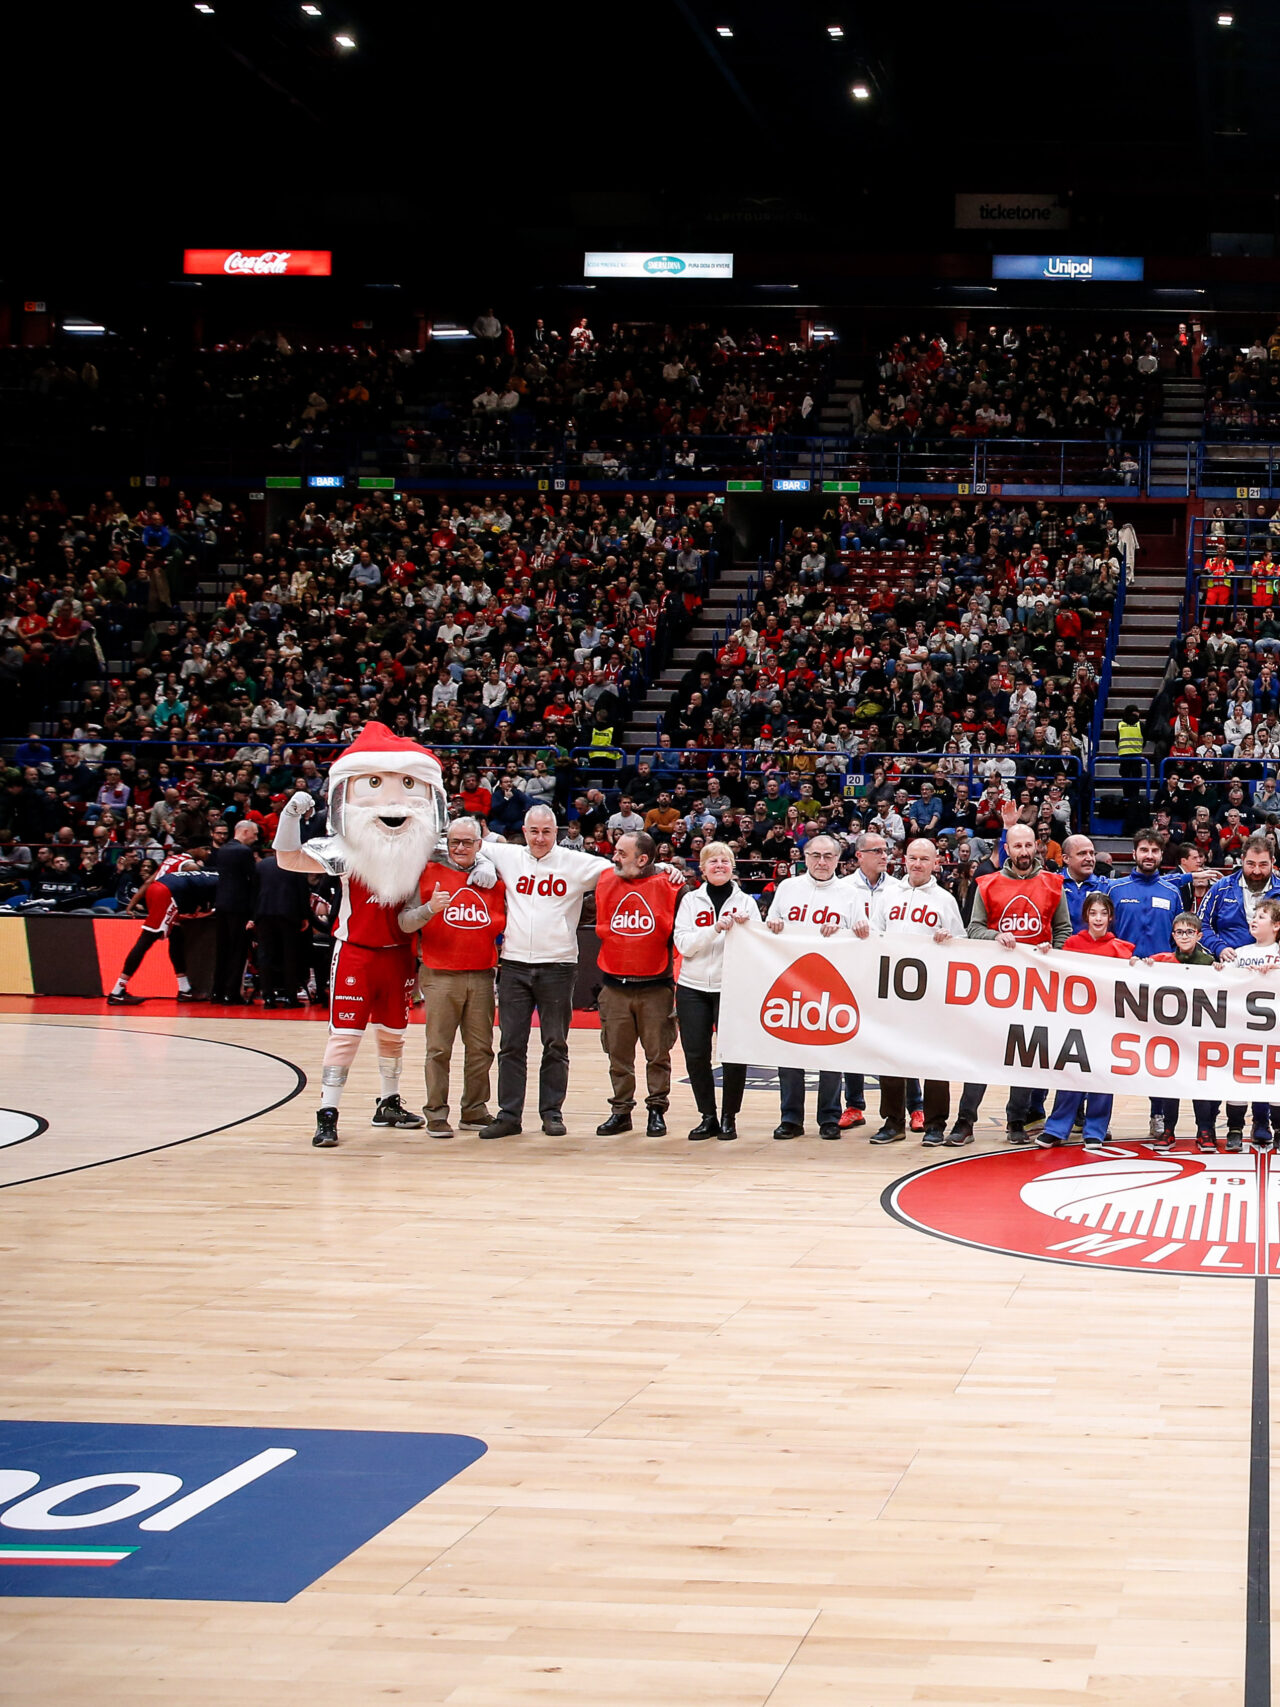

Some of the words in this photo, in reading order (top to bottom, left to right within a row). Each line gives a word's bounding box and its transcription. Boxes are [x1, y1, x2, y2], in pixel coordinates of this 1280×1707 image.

[980, 204, 1051, 220] ticketone
[1048, 257, 1093, 278] Unipol
[316, 477, 335, 486] BAR
[555, 481, 565, 489] 19
[782, 481, 800, 490] BAR
[976, 484, 986, 492] 20
[1250, 488, 1259, 496] 21
[848, 776, 861, 785] 20
[446, 903, 489, 923] aido
[612, 910, 653, 930] aido
[1001, 913, 1040, 932] aido
[878, 955, 928, 1001] IO
[945, 961, 1098, 1015] DONO
[1114, 980, 1228, 1029] NON
[338, 1012, 357, 1020] EA7
[763, 991, 858, 1034] aido
[1004, 1023, 1092, 1073] MA
[1110, 1032, 1180, 1078] SO
[1206, 1177, 1246, 1186] 19
